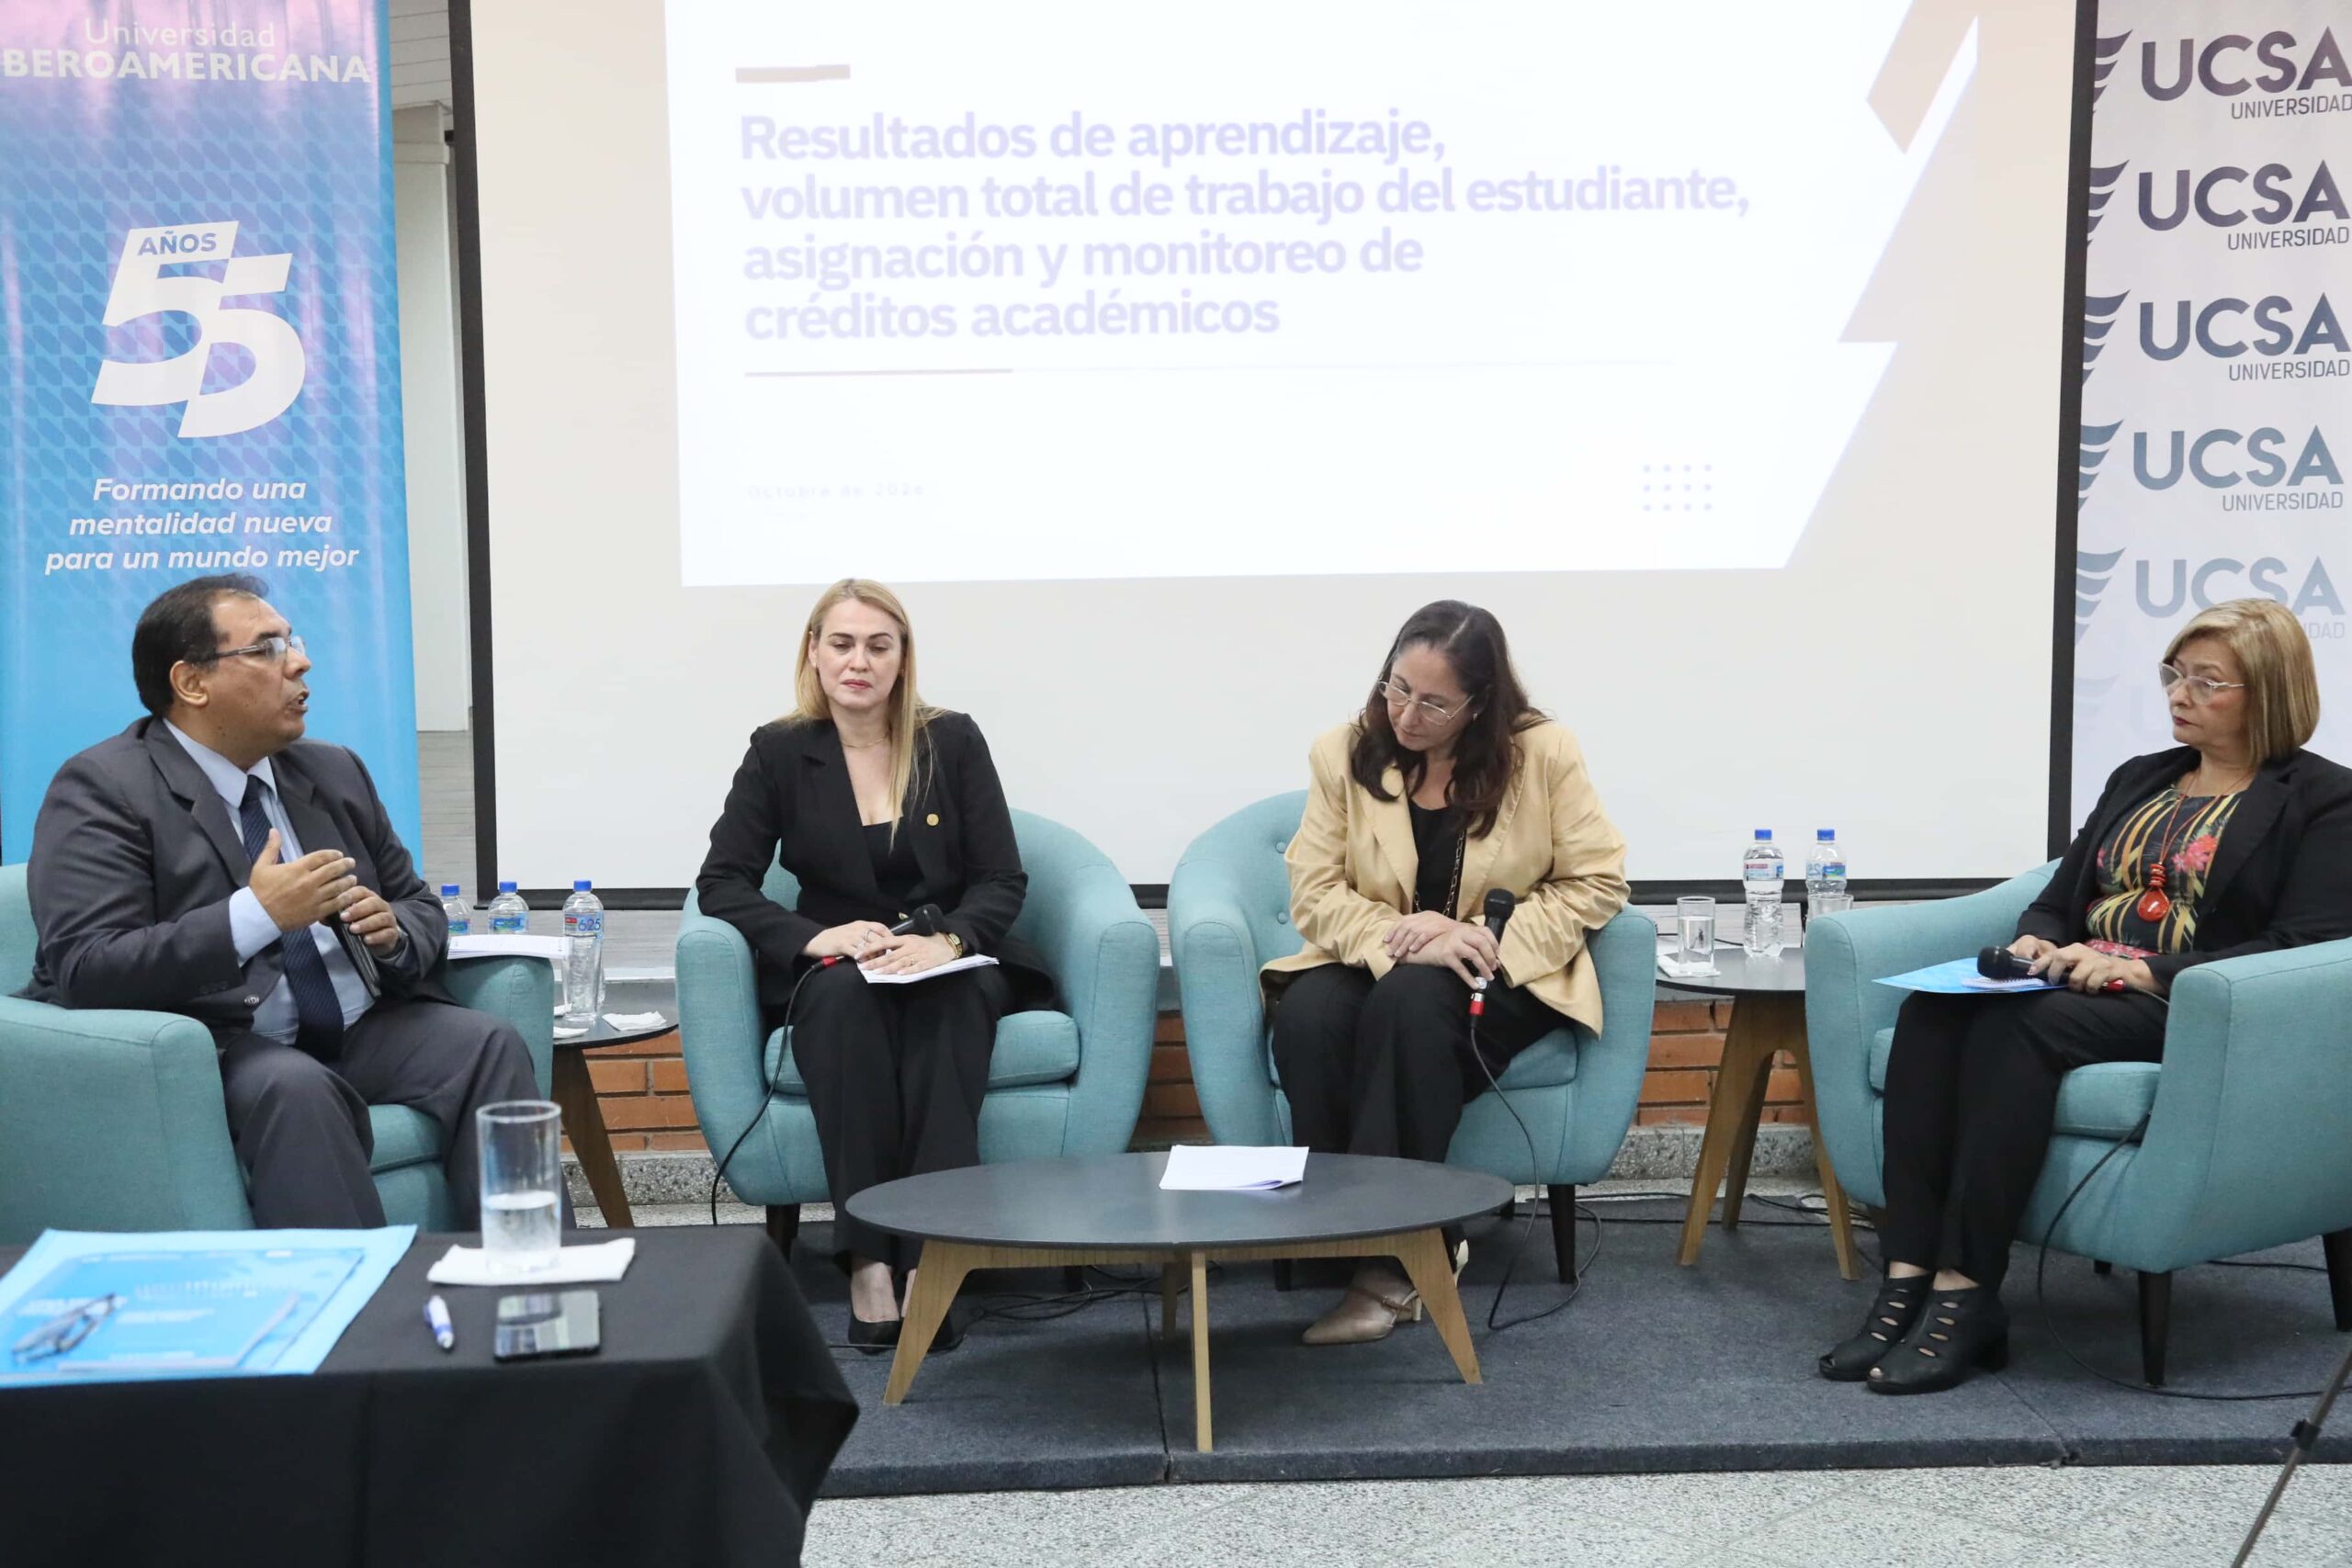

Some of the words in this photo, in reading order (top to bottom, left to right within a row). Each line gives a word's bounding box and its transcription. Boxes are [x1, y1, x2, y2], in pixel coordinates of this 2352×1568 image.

[85, 18, 275, 47] Universidad
[2, 48, 371, 83] BEROAMERICANA
[2142, 26, 2352, 101] UCSA
[2231, 95, 2352, 119] UNIVERSIDAD
[741, 111, 1037, 161] Resultados
[1049, 110, 1115, 159] de
[1127, 107, 1446, 168] aprendizaje,
[740, 173, 968, 220] volumen
[981, 170, 1099, 217] total
[1109, 170, 1174, 216] de
[1185, 169, 1364, 226] trabajo
[1376, 166, 1456, 213] del
[1465, 164, 1750, 217] estudiante,
[2138, 159, 2350, 231] UCSA
[137, 231, 218, 256] AÑOS
[2227, 226, 2350, 251] UNIVERSIDAD
[742, 230, 1024, 292] asignación
[1036, 242, 1069, 288] y
[1082, 228, 1347, 276] monitoreo
[1360, 226, 1424, 273] de
[744, 291, 958, 340] créditos
[970, 288, 1281, 337] académicos
[2140, 292, 2351, 361] UCSA
[2228, 359, 2350, 381] UNIVERSIDAD
[2133, 424, 2345, 491] UCSA
[93, 478, 243, 501] Formando
[252, 480, 307, 500] una
[2222, 491, 2344, 512] UNIVERSIDAD
[69, 512, 236, 536] mentalidad
[243, 514, 332, 534] nueva
[45, 550, 113, 576] para
[122, 549, 159, 570] un
[168, 547, 268, 570] mundo
[277, 546, 359, 572] mejor
[2135, 556, 2346, 619] UCSA
[578, 918, 602, 932] 625
